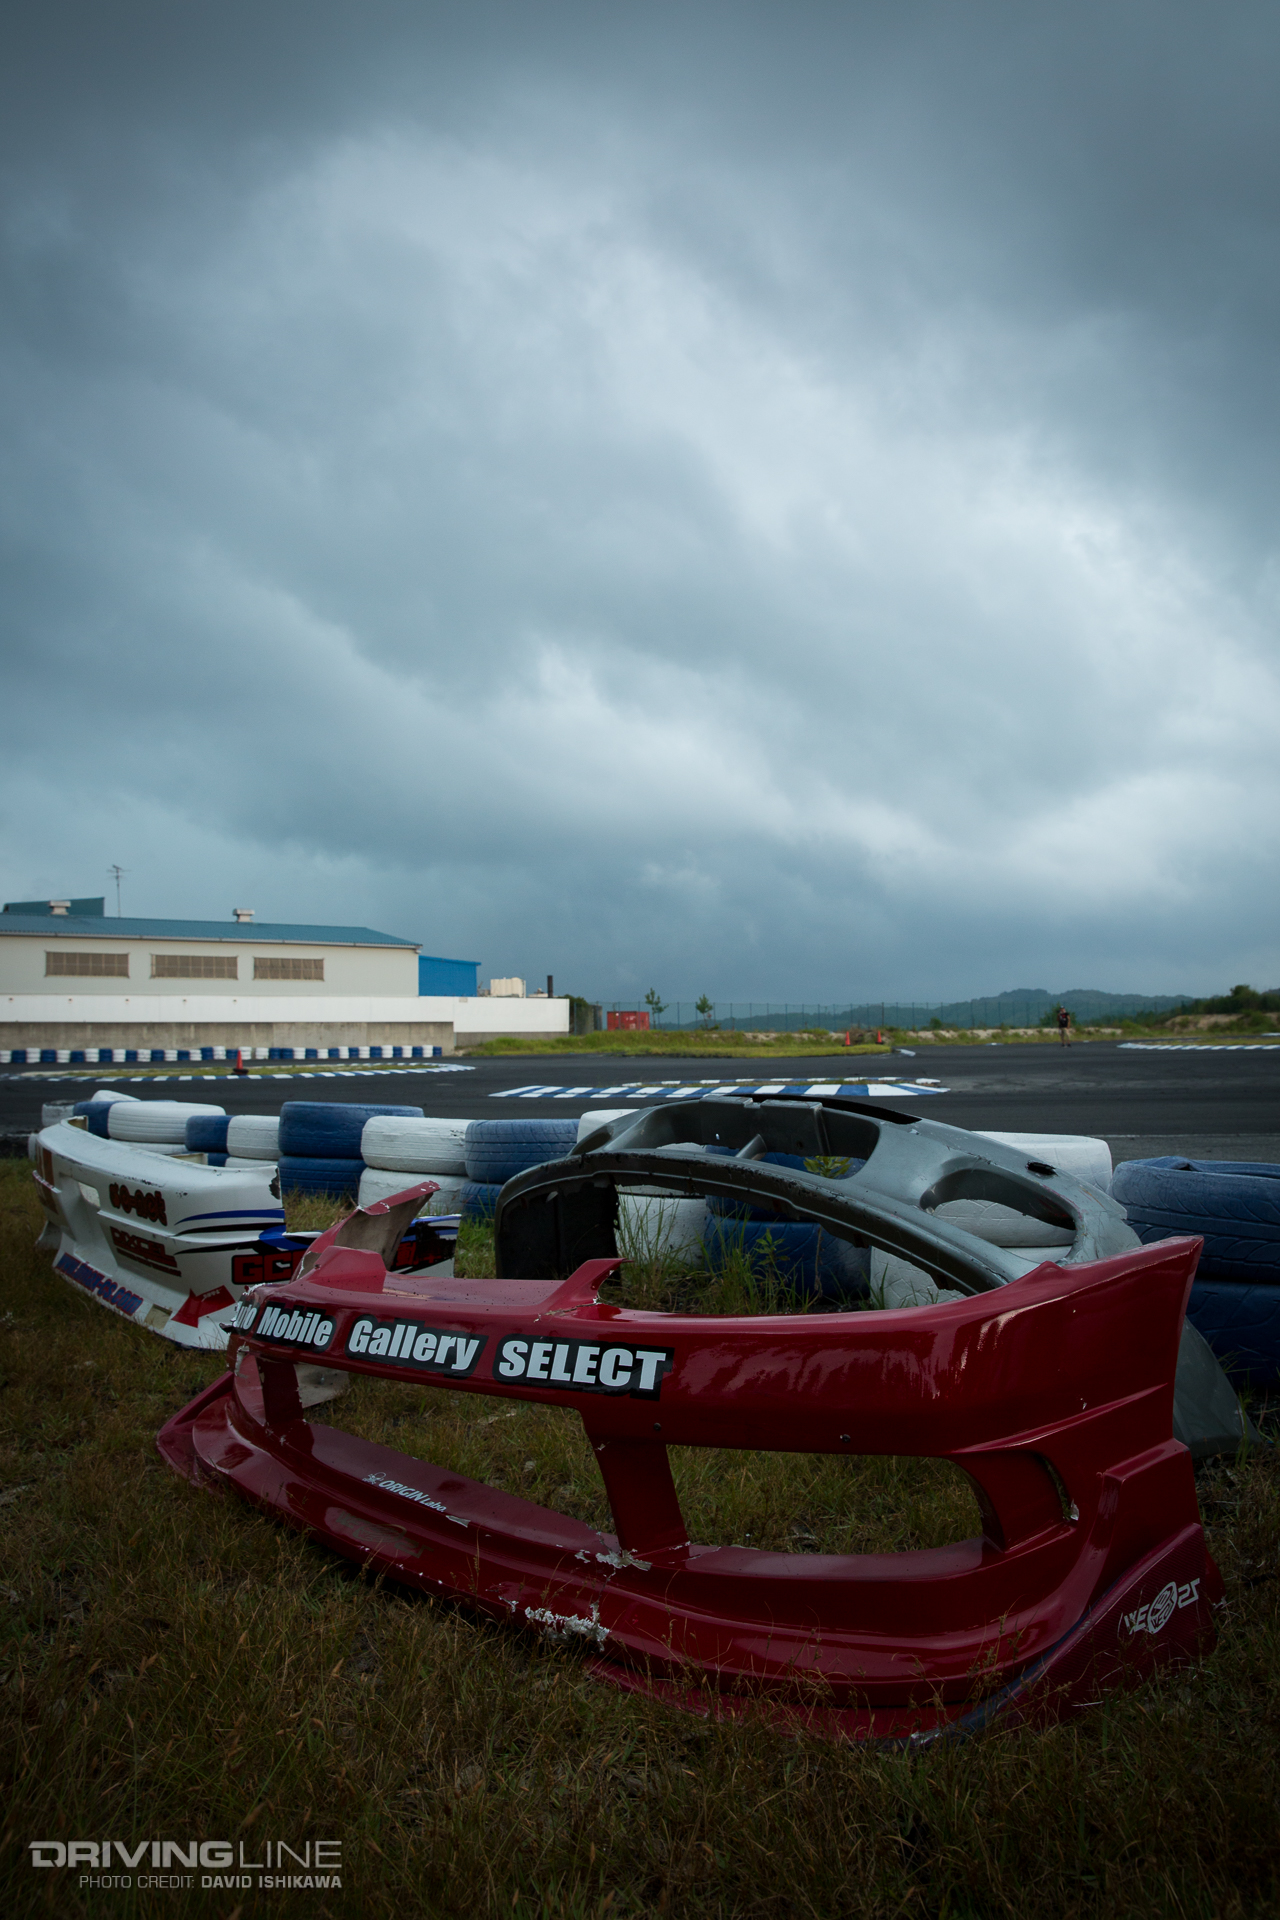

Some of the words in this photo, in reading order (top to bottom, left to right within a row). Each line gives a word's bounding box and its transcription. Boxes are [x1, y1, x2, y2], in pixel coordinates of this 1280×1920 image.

[256, 1306, 333, 1348] Mobile
[348, 1319, 480, 1371] Gallery
[498, 1339, 666, 1391] SELECT
[378, 1480, 429, 1503] ORIGIN
